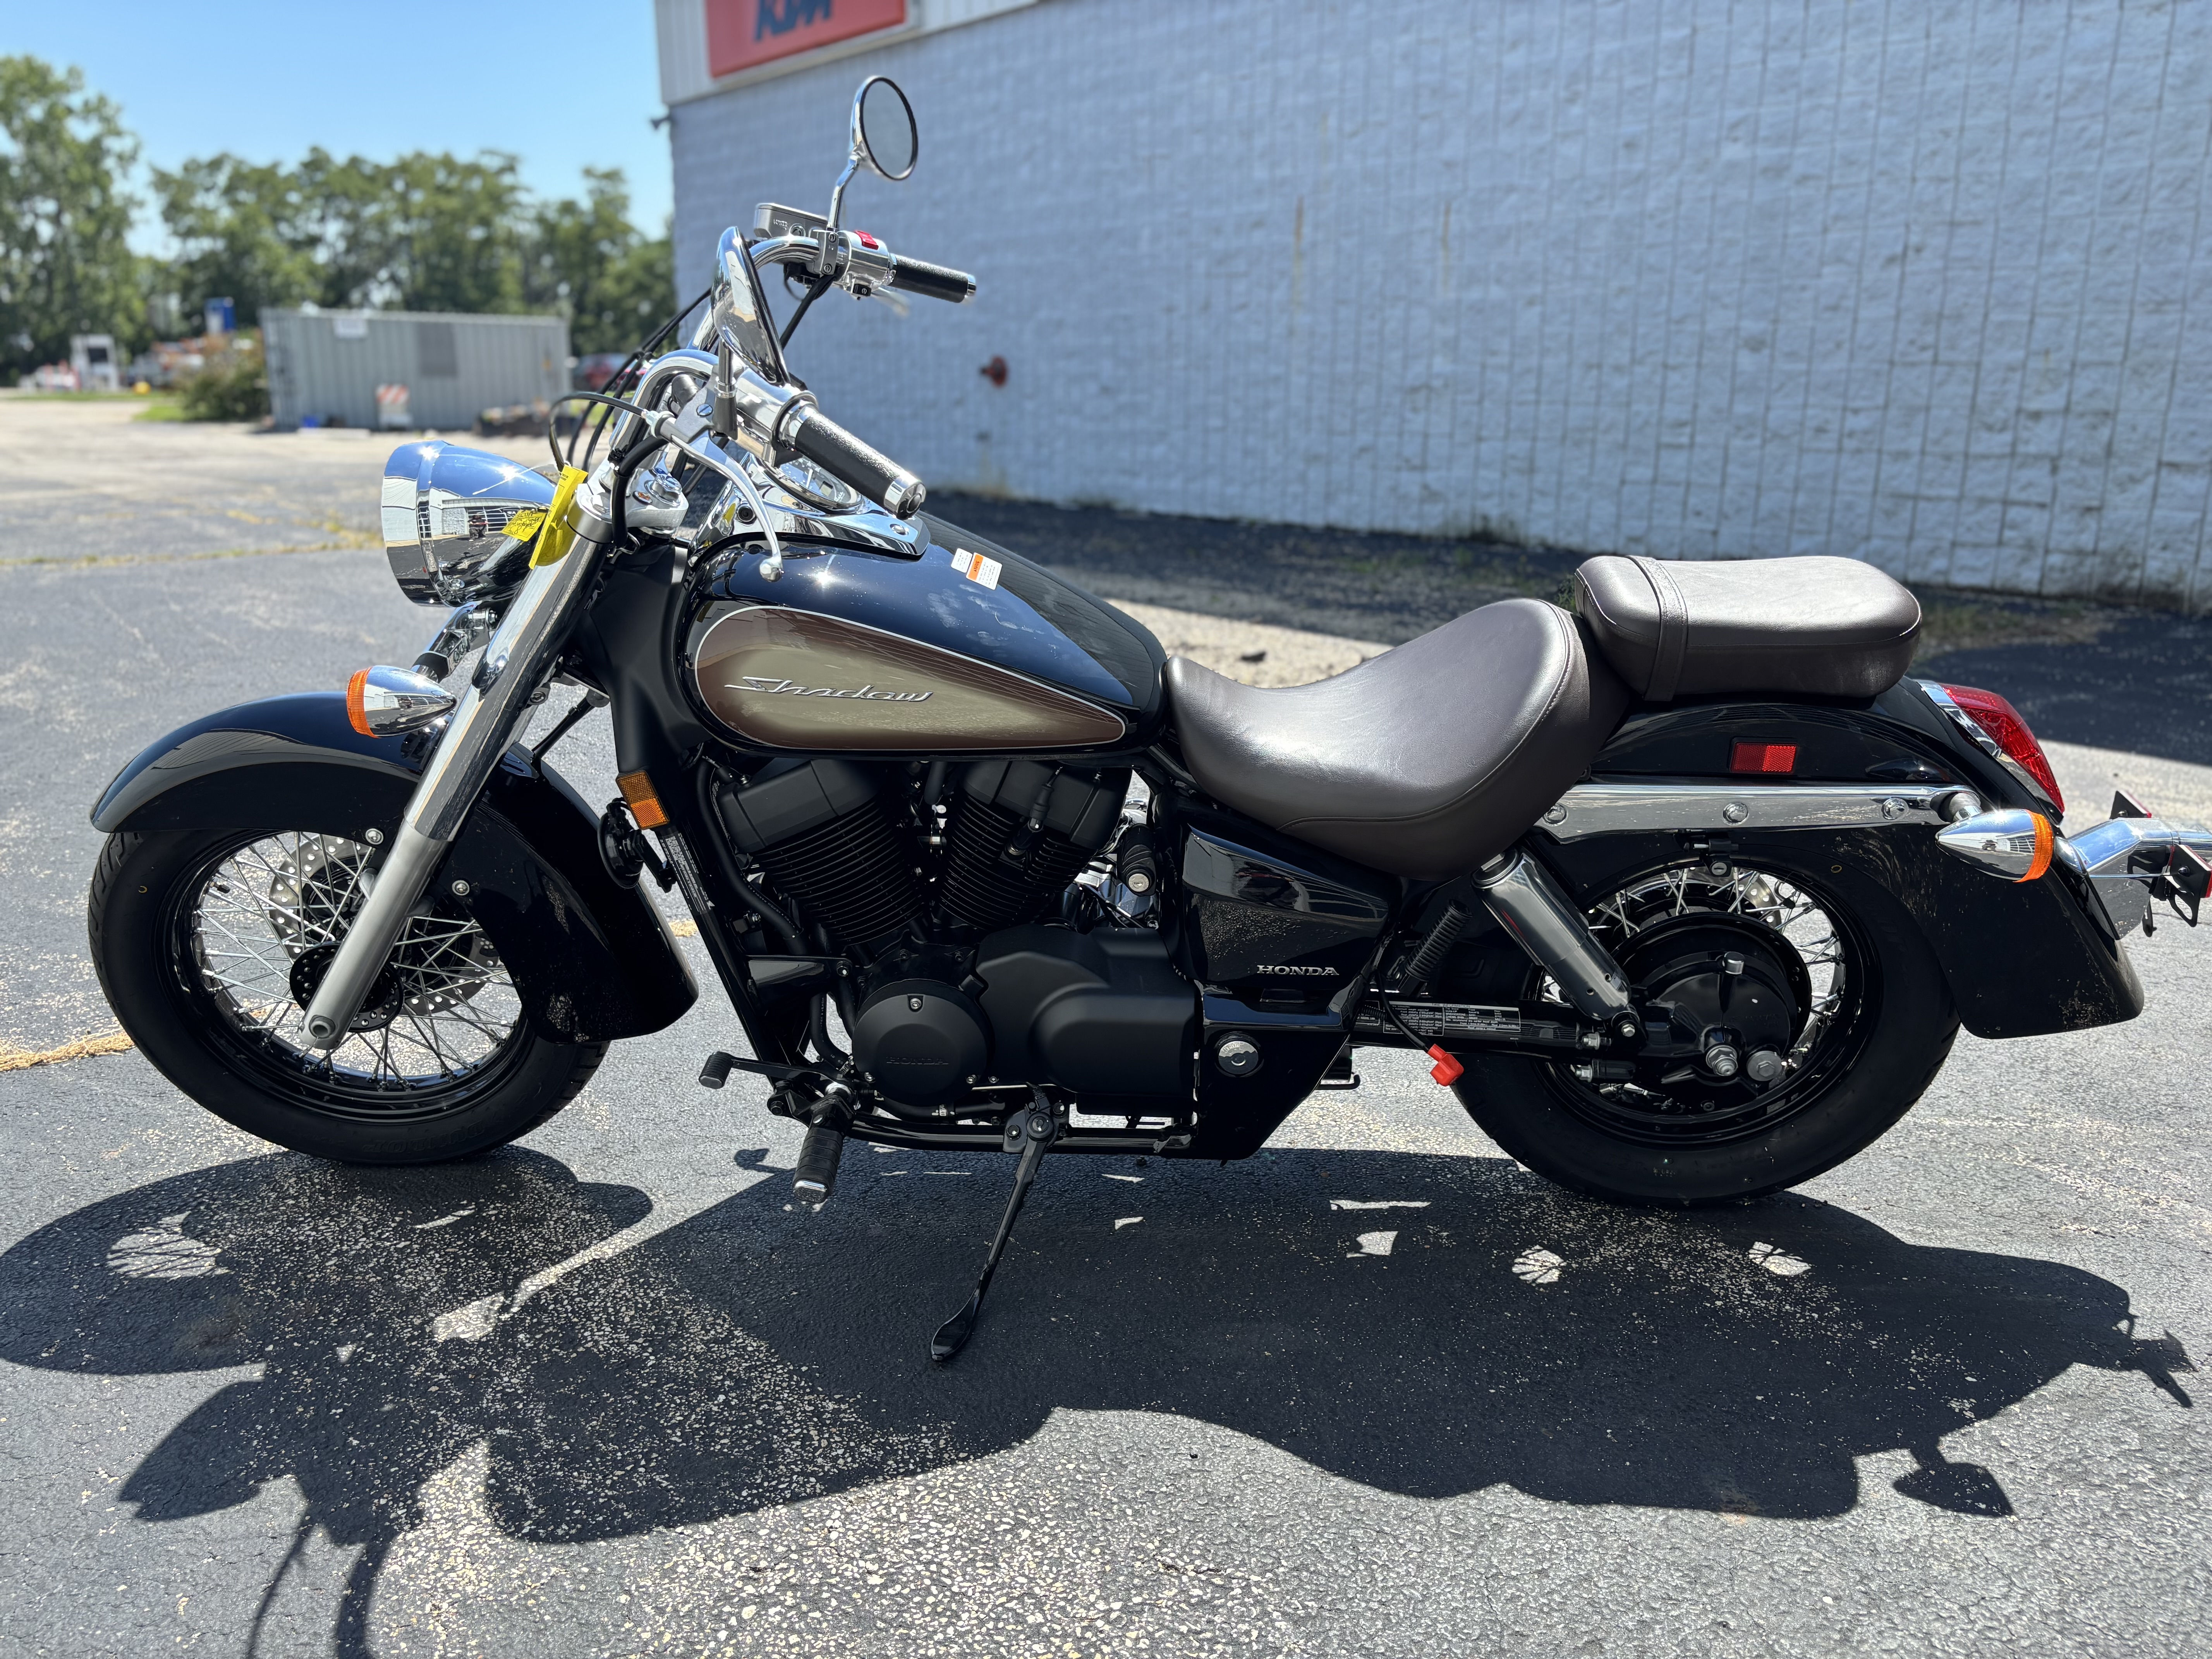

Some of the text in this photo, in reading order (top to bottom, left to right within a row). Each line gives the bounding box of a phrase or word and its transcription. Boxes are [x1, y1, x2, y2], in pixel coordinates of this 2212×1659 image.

[724, 676, 933, 702] Shadow
[1257, 965, 1340, 975] HONDA
[886, 1056, 949, 1065] HONDA
